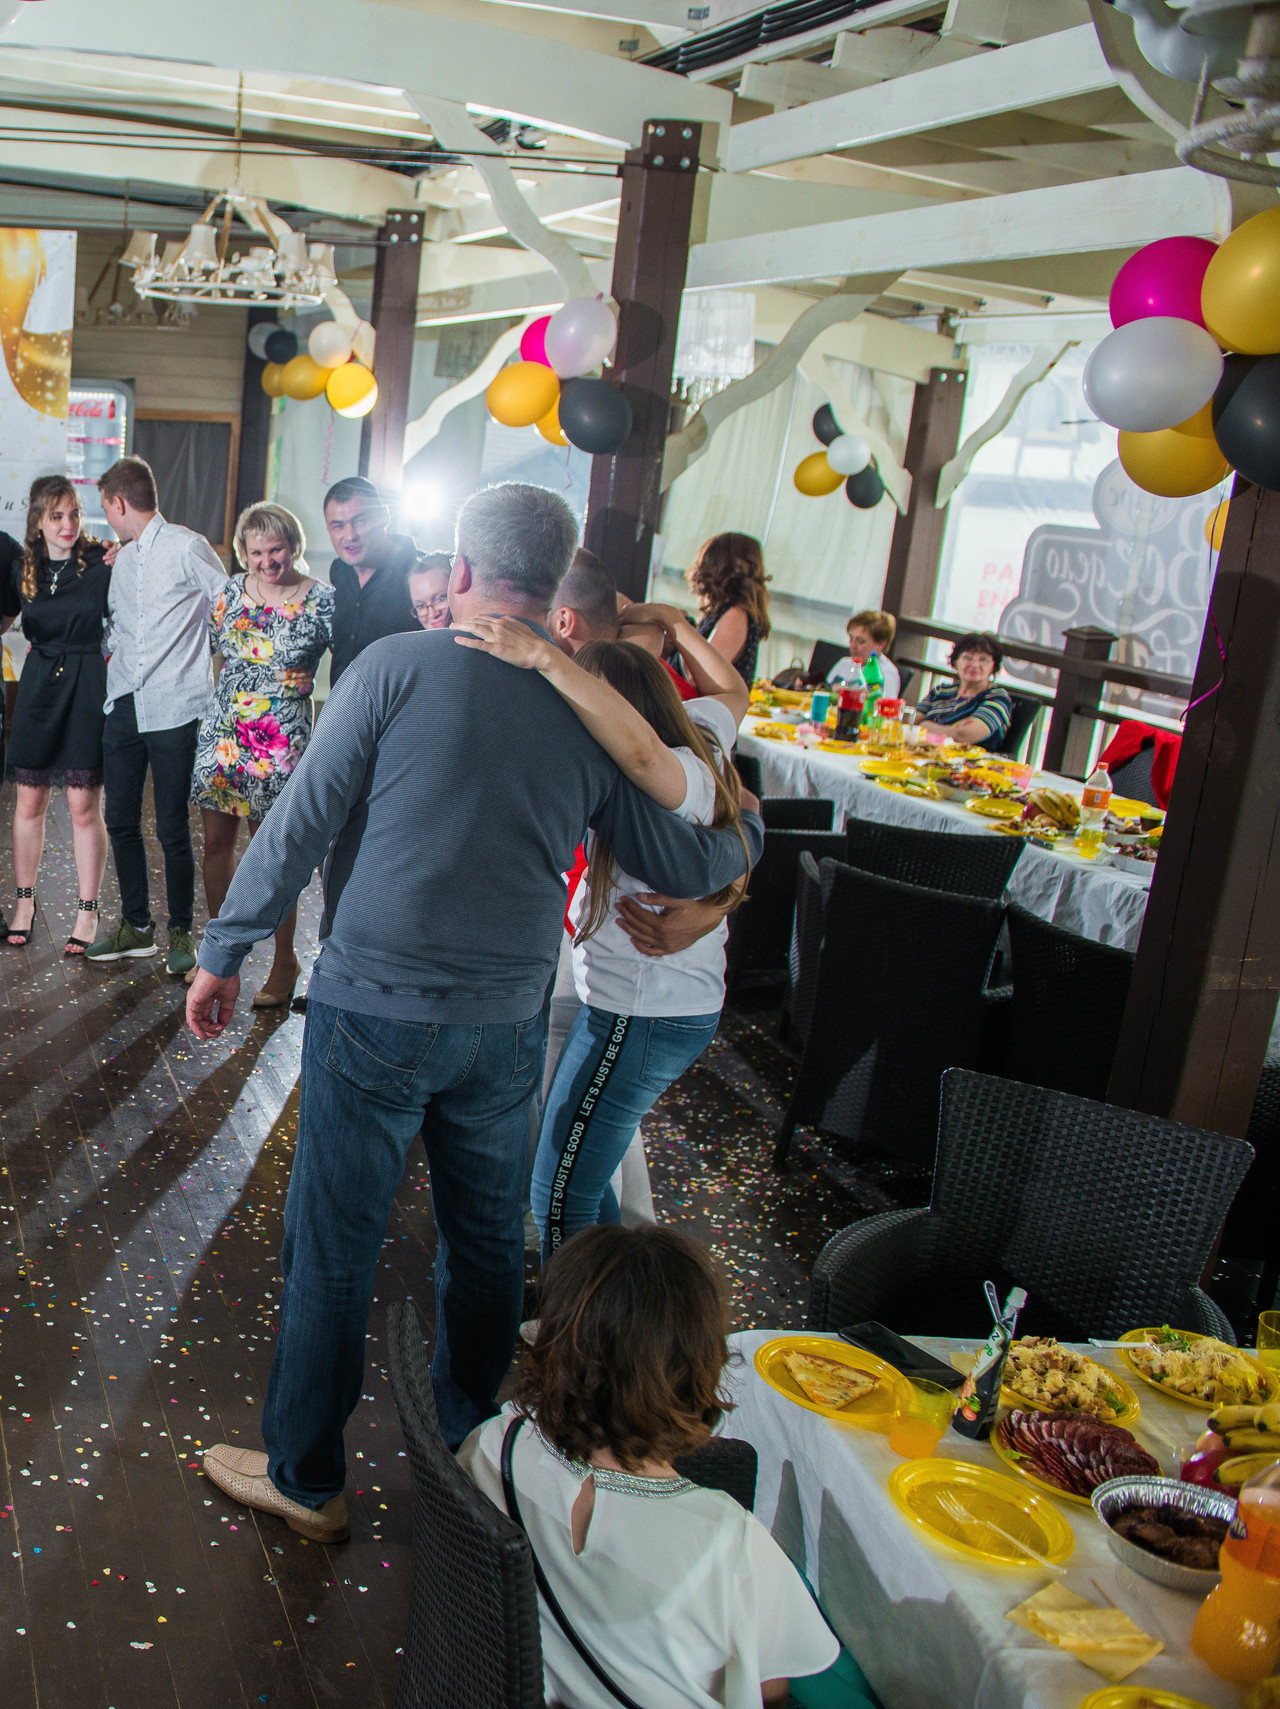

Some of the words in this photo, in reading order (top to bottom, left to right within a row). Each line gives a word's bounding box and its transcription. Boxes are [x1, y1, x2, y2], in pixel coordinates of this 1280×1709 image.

[593, 1059, 612, 1087] JUST
[605, 1043, 620, 1060] BE
[567, 1121, 585, 1152] GOOD
[561, 1152, 575, 1168] BE
[551, 1226, 562, 1253] OOD
